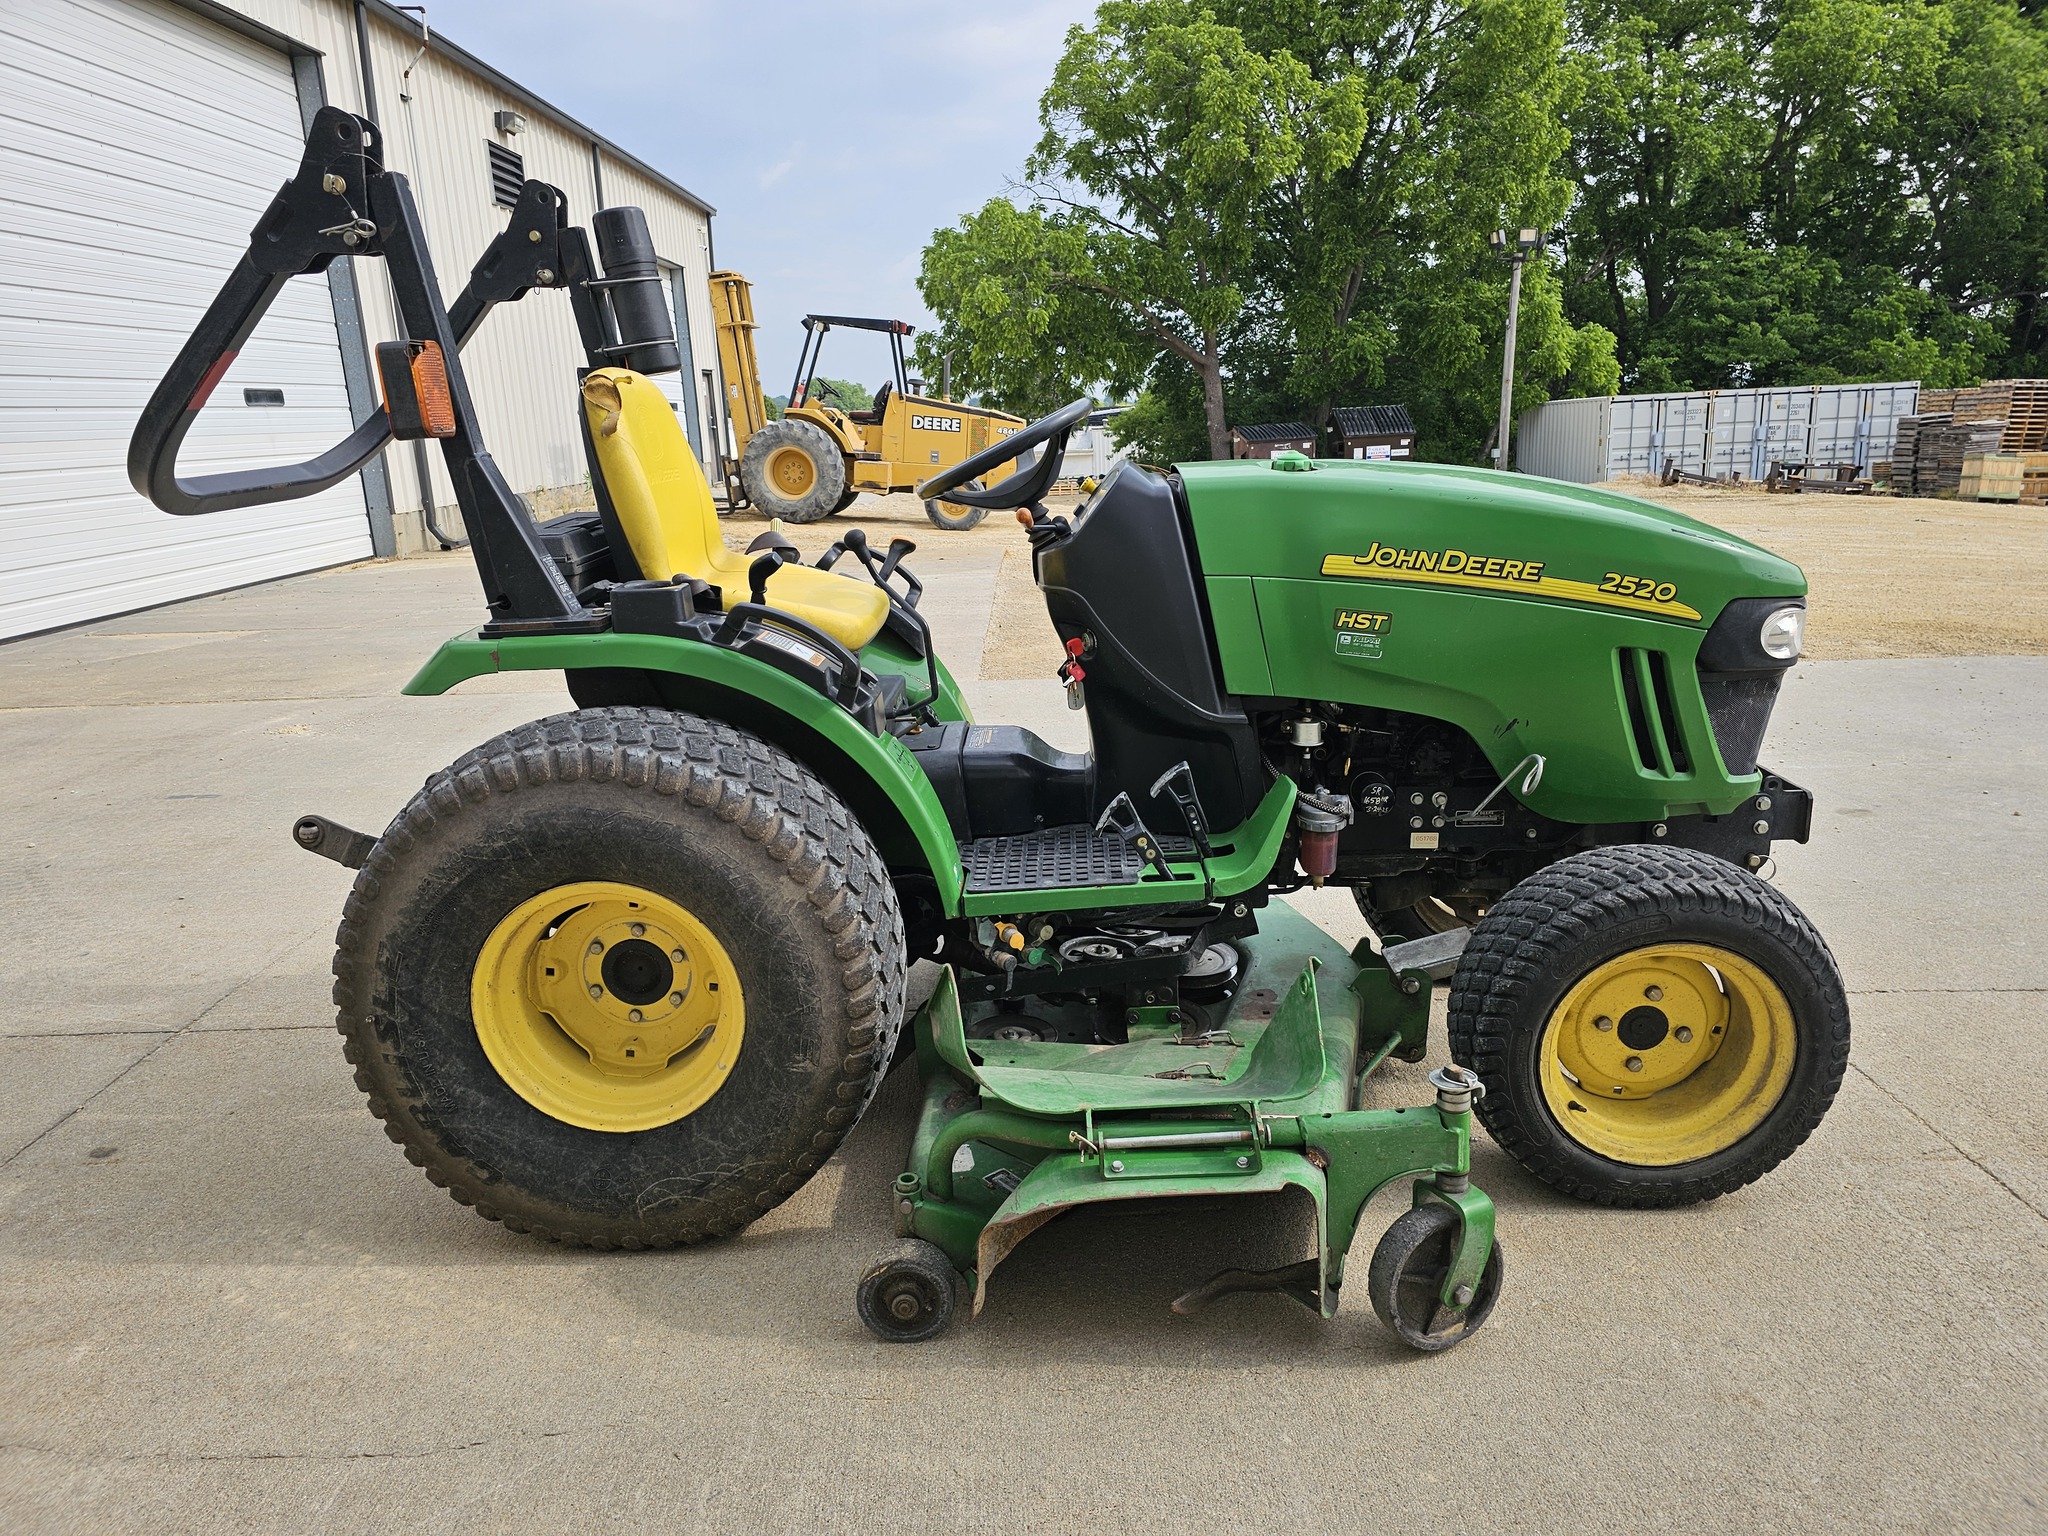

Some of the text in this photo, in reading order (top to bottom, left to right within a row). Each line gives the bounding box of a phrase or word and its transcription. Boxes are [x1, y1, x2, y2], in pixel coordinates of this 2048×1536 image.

[912, 415, 961, 432] DEERE
[1354, 542, 1677, 602] JOHN DEERE 2520
[1337, 611, 1389, 630] HST
